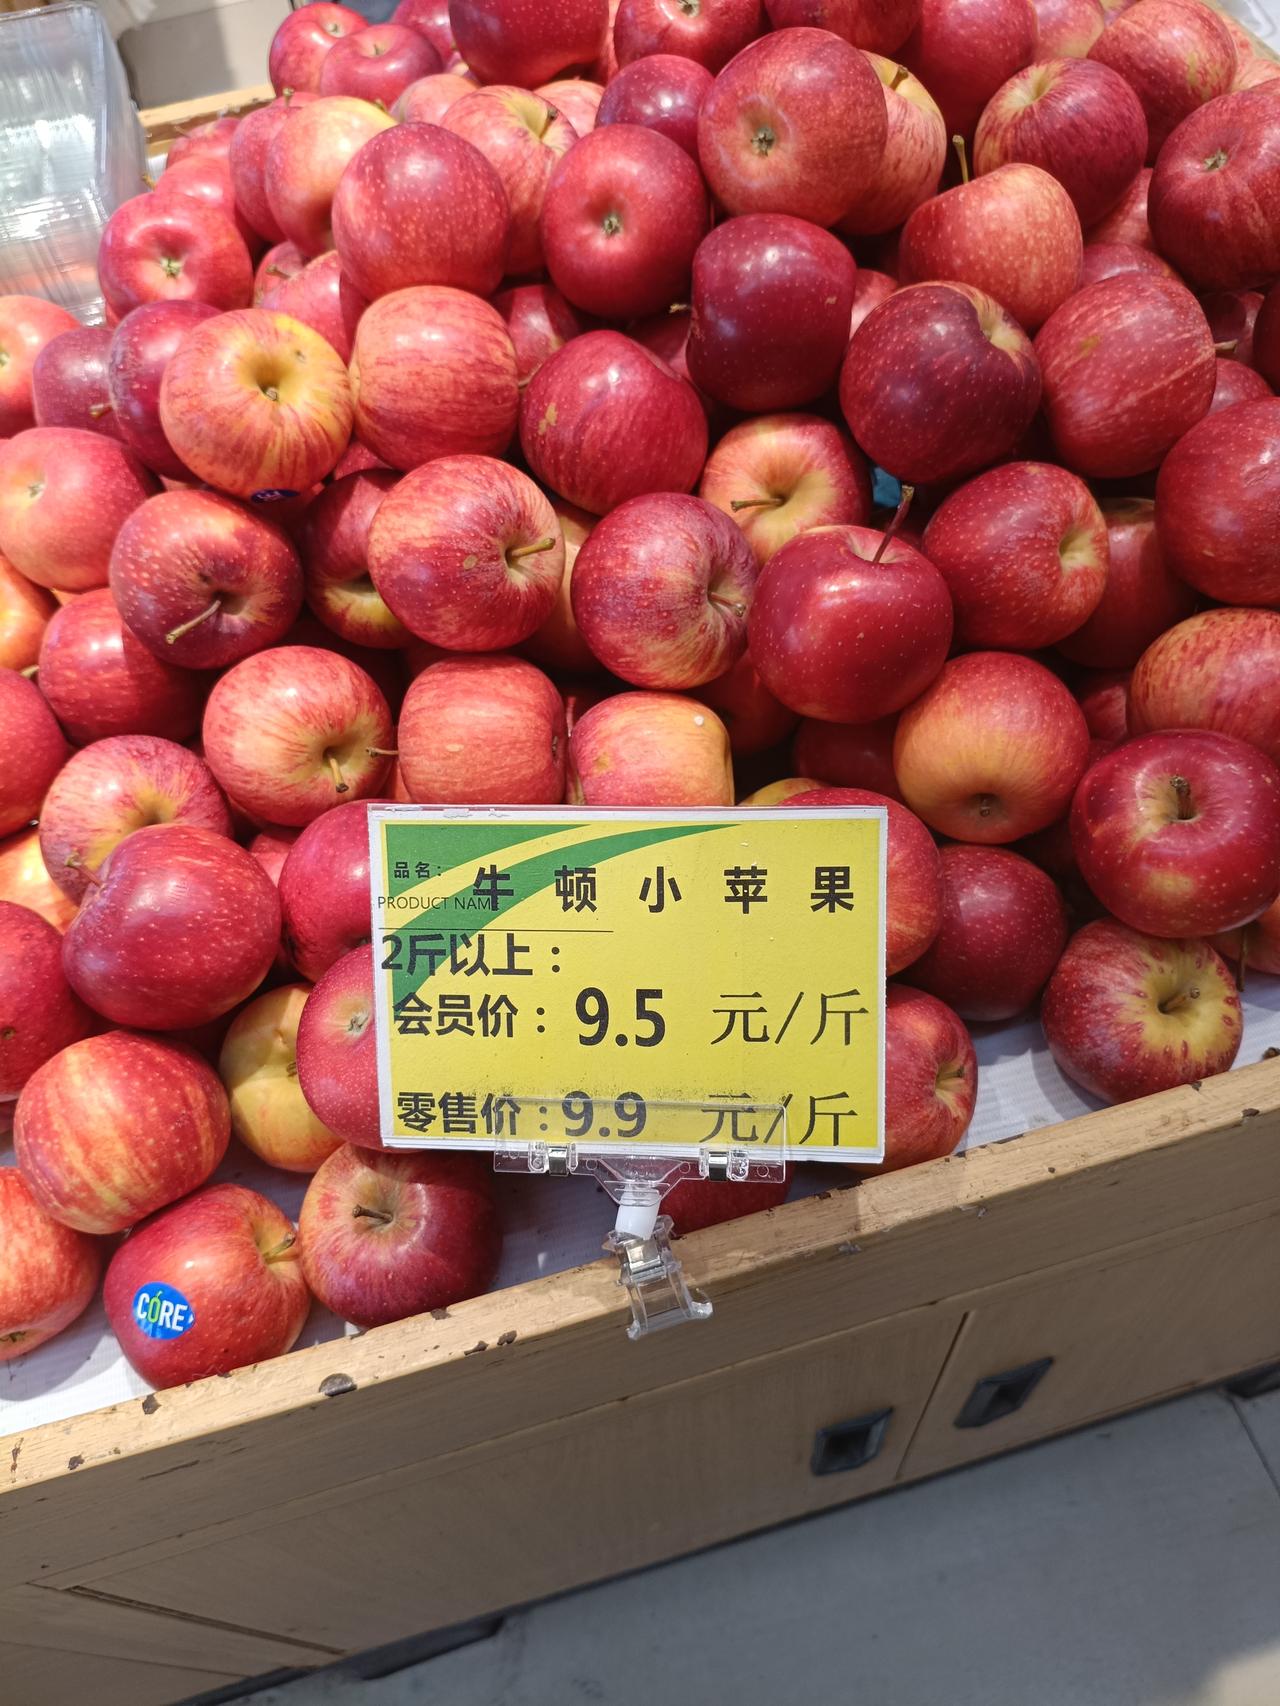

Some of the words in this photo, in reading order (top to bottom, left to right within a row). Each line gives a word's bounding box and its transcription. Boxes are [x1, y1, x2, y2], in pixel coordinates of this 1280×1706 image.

[377, 896, 449, 910] PRODUCT
[381, 933, 561, 976] 2斤以上：
[394, 993, 546, 1038] 会员价：
[576, 987, 666, 1047] 9.5
[711, 989, 869, 1046] 元/斤
[562, 1090, 648, 1137] 9.9
[700, 1091, 858, 1146] 元/斤
[136, 1289, 188, 1331] CORE
